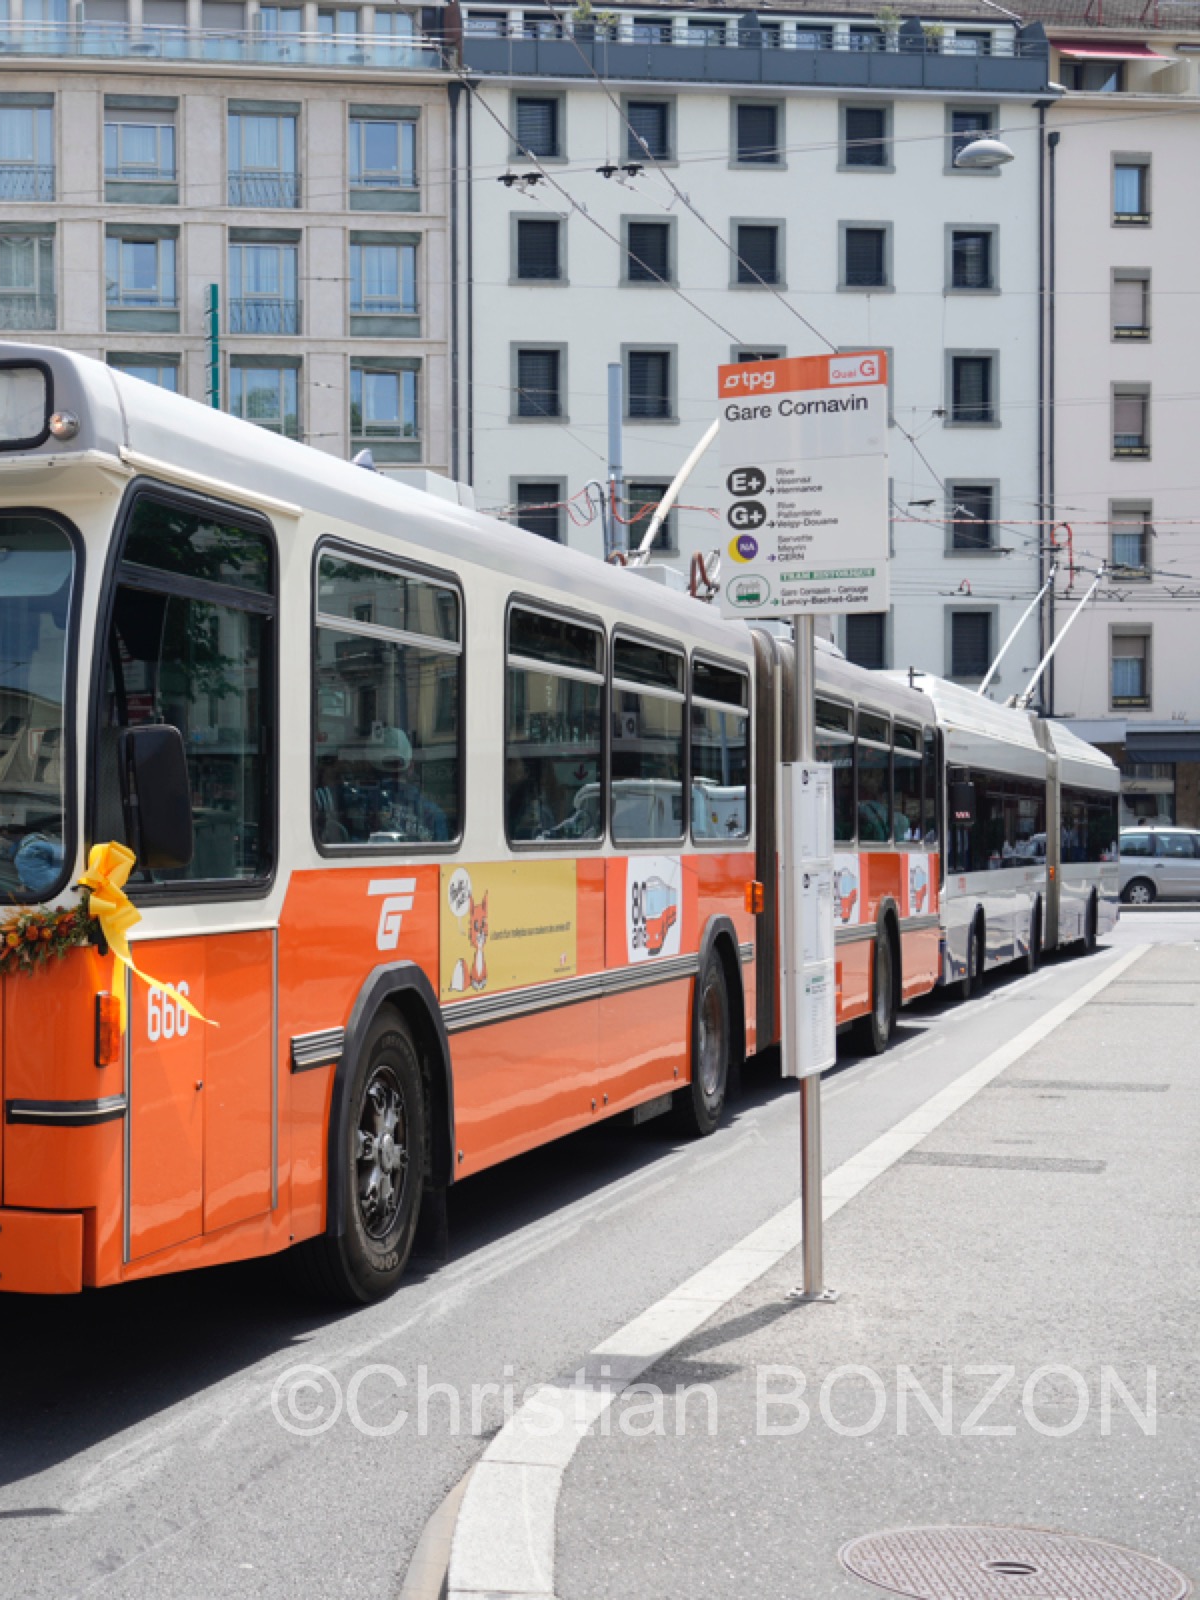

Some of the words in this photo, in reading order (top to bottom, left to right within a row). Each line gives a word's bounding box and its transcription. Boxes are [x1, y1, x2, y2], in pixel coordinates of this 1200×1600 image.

[860, 360, 876, 377] G
[742, 371, 775, 390] tpg
[725, 404, 772, 422] Gare
[778, 394, 868, 417] Cornavin
[731, 473, 761, 491] E+
[731, 506, 762, 525] G+
[148, 981, 189, 1042] 666
